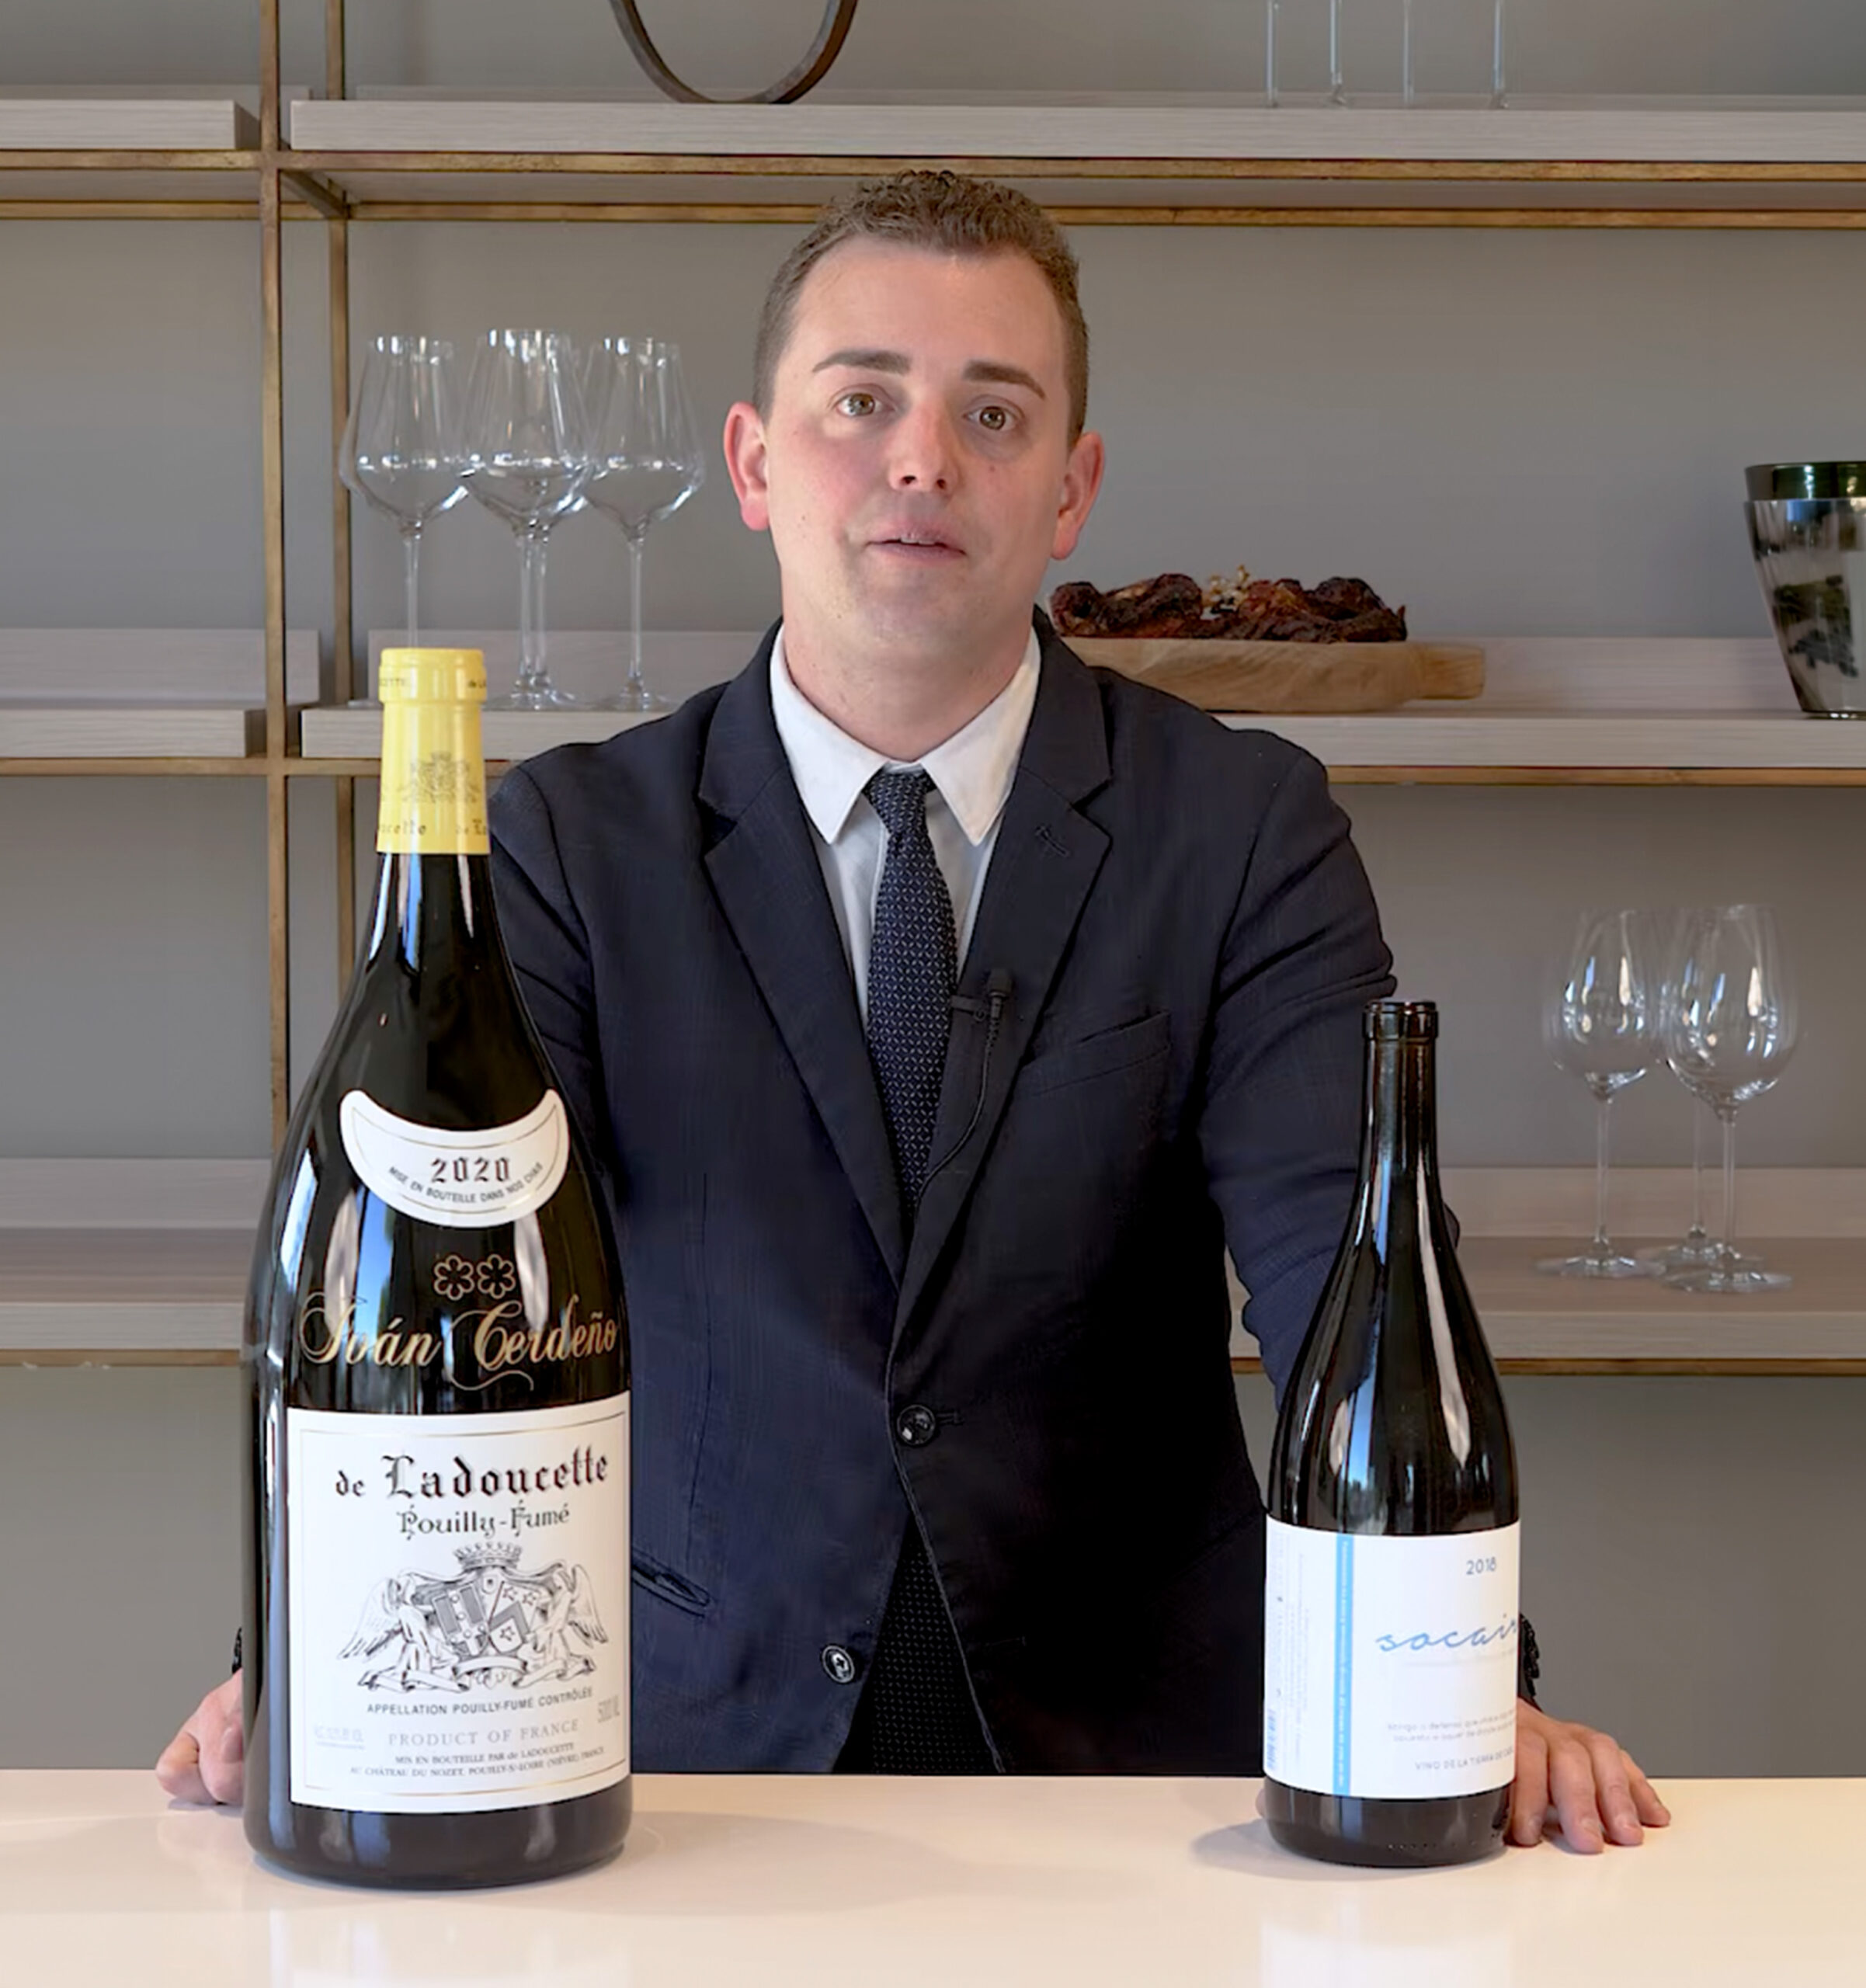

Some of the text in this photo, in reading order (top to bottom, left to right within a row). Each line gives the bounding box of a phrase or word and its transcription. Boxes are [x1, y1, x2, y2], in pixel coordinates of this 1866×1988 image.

[431, 1156, 509, 1183] 2020
[389, 1166, 408, 1184] MISE
[411, 1180, 423, 1194] EN
[426, 1187, 476, 1203] BOUTEILLE
[480, 1190, 505, 1203] DANS
[506, 1180, 524, 1194] NOS
[299, 1291, 618, 1392] Iván Cerdeño
[335, 1444, 608, 1499] de Ladoucette
[397, 1500, 570, 1540] Pouilly-Fumé
[367, 1703, 447, 1715] APPELLATION
[389, 1719, 579, 1746] PRODUCT OF FRANCE
[415, 1756, 428, 1764] EN
[432, 1753, 485, 1764] BOUTEILLE
[1415, 1760, 1440, 1771] VINO
[1444, 1759, 1455, 1770] DE
[1457, 1757, 1468, 1768] LA
